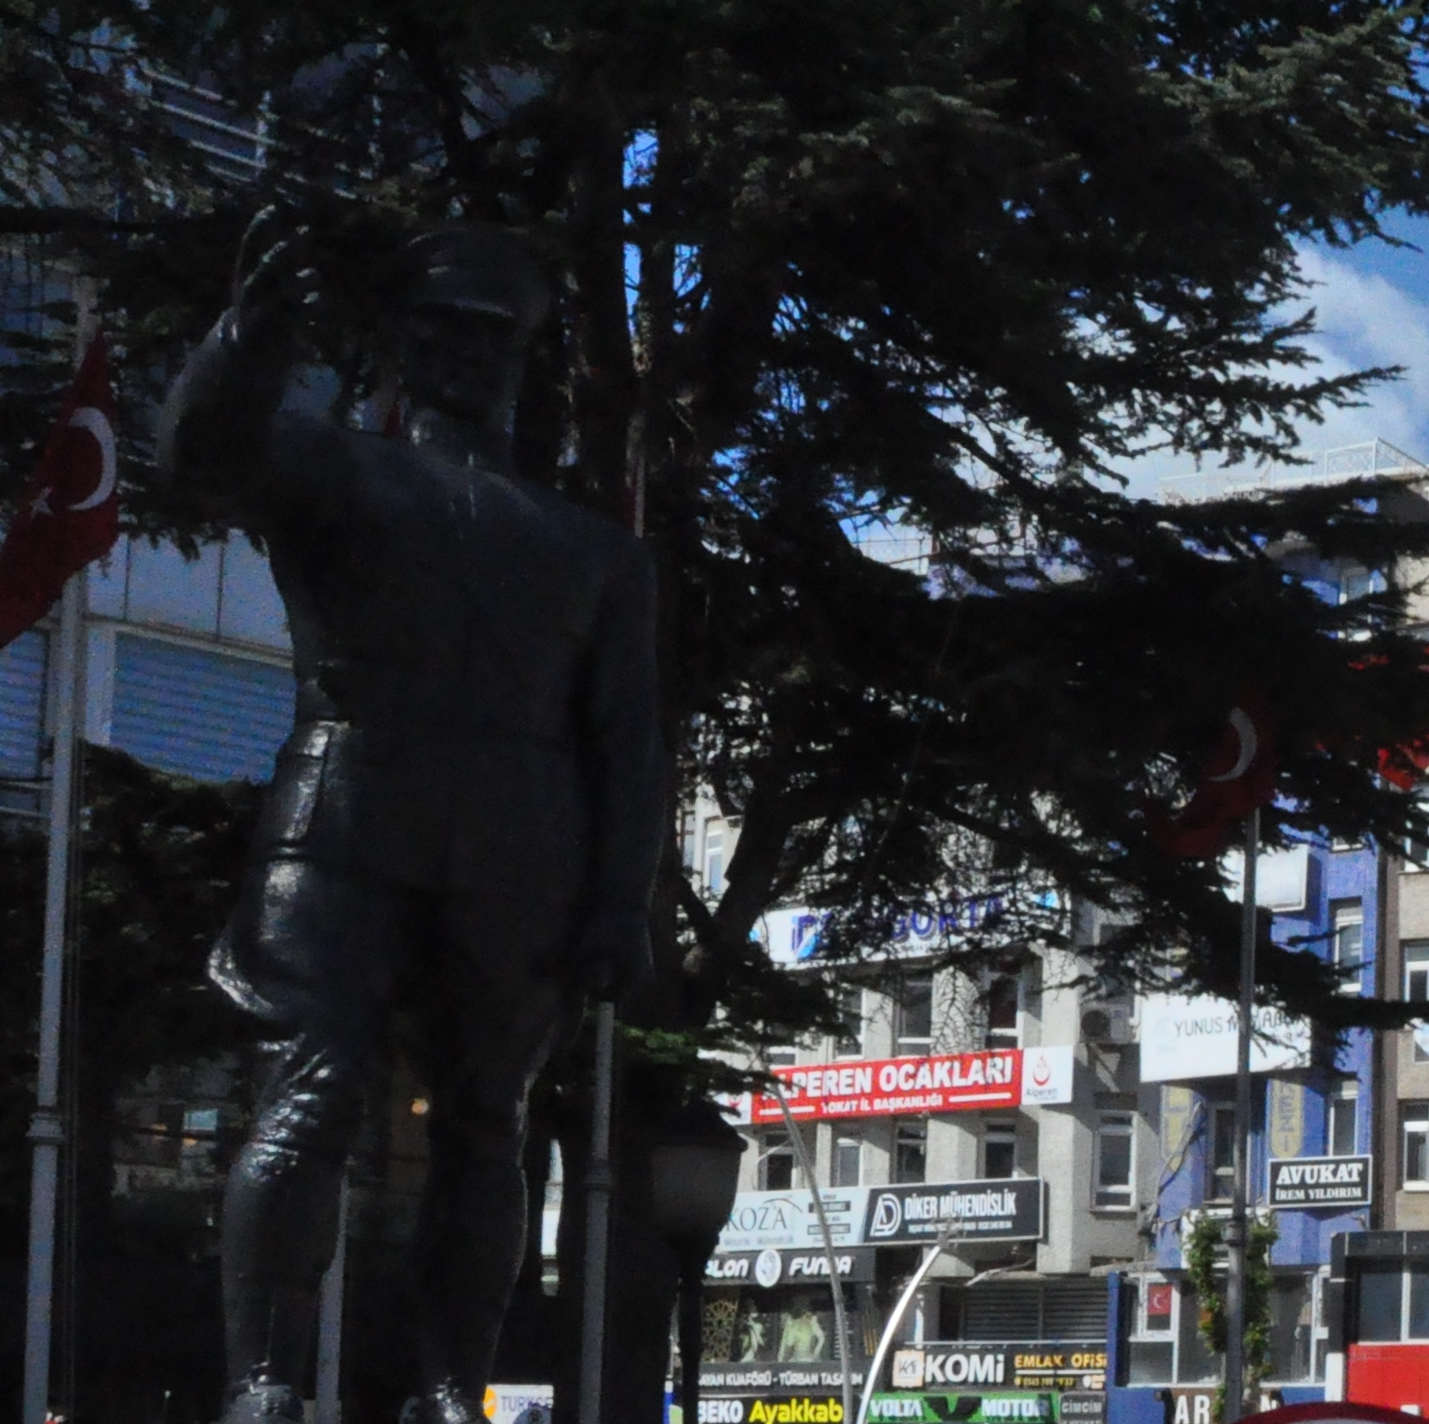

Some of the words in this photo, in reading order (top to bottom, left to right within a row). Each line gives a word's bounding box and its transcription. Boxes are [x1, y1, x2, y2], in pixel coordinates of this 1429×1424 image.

[1173, 1016, 1223, 1038] YUNUS
[878, 1056, 1014, 1095] OCAKLARI
[860, 1097, 872, 1113] İL
[873, 1094, 944, 1113] BAŞKANLIĞI
[1275, 1162, 1364, 1186] AVUKAT
[1275, 1187, 1306, 1201] İREM
[1307, 1186, 1363, 1200] YILDIRIM
[904, 1192, 938, 1220] DİKER
[939, 1188, 1017, 1219] MÜHENDİSLİK
[1014, 1354, 1064, 1369] EMLAK
[698, 1373, 724, 1387] AYAN
[725, 1370, 772, 1387] KUAFÖRÜ
[779, 1370, 819, 1387] TÜRBAN
[820, 1371, 863, 1387] TASAIM
[869, 1399, 923, 1417] VOLTA
[980, 1398, 1050, 1417] MOTOR
